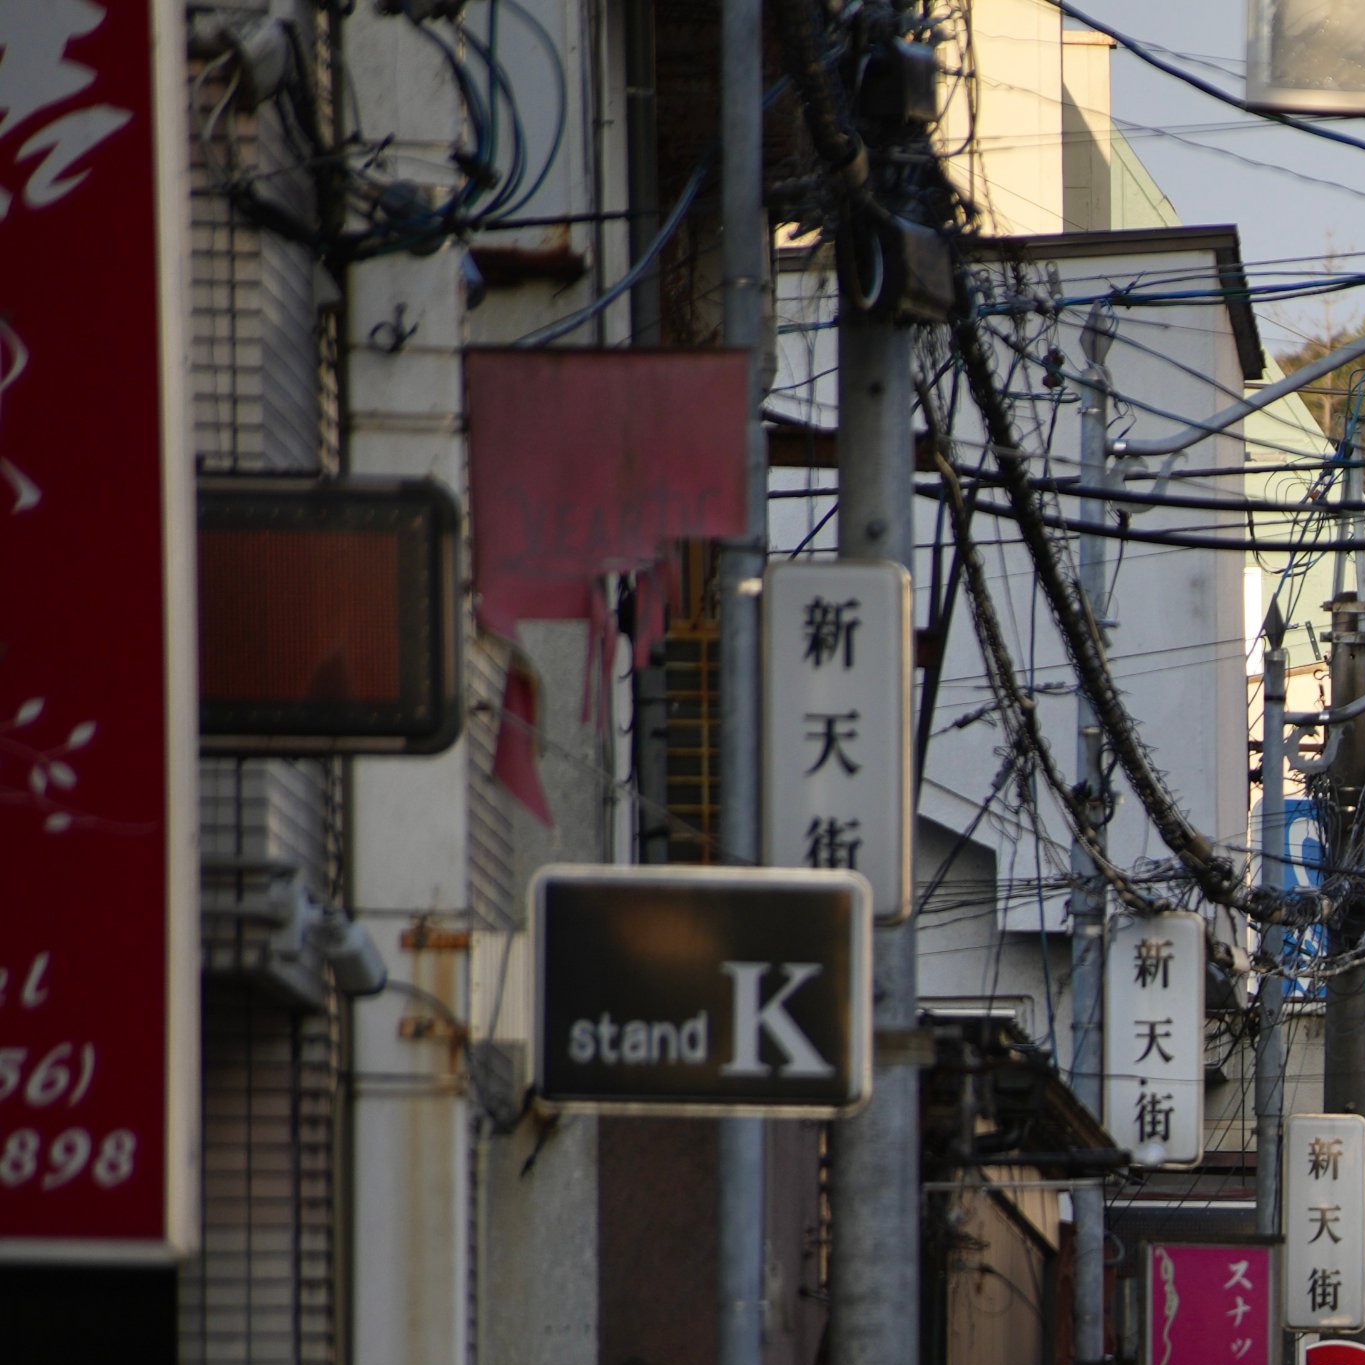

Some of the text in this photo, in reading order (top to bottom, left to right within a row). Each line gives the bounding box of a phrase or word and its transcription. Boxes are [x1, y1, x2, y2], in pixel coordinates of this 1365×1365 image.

[803, 596, 862, 869] 新天街
[568, 961, 836, 1078] stand K
[1134, 938, 1174, 1143] 新天街
[1307, 1137, 1343, 1313] 新天街
